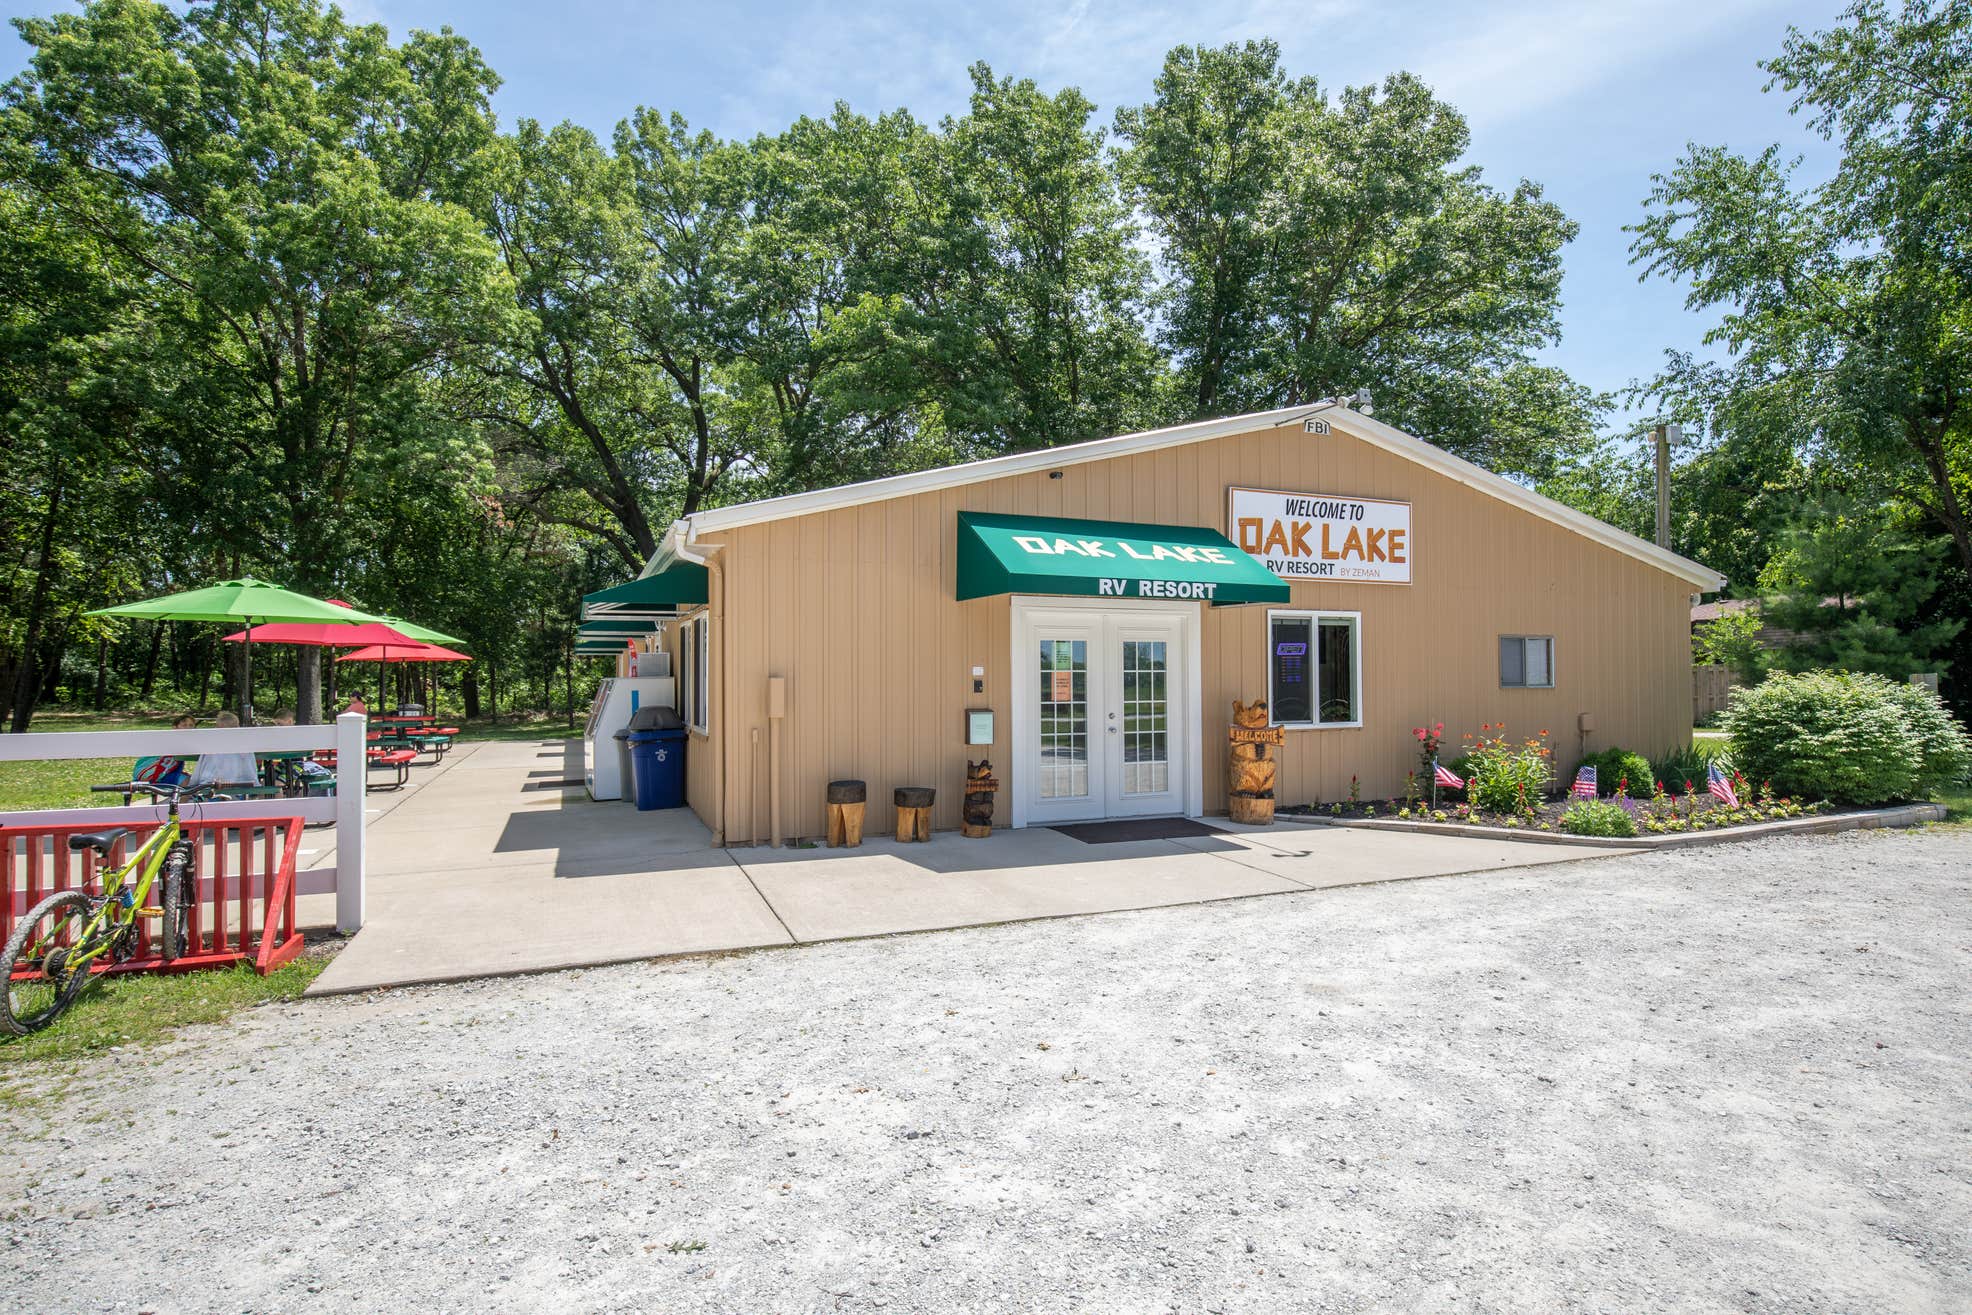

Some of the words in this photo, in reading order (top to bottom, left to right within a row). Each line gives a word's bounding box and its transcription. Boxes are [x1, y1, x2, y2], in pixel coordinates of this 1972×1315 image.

[1307, 421, 1328, 434] FBI
[1285, 498, 1347, 520] WELCOME
[1350, 503, 1364, 521] TO
[1238, 517, 1313, 558] OAK
[1321, 523, 1406, 563] LAKE
[1012, 536, 1116, 558] OAK
[1117, 542, 1235, 565] LAKE
[1267, 560, 1284, 573] RV
[1287, 561, 1335, 576] RESORT
[1340, 567, 1351, 577] BY
[1352, 568, 1381, 577] ZEMAN
[1099, 578, 1127, 596] RV
[1138, 580, 1217, 599] RESORT
[1235, 730, 1279, 743] WELCOME
